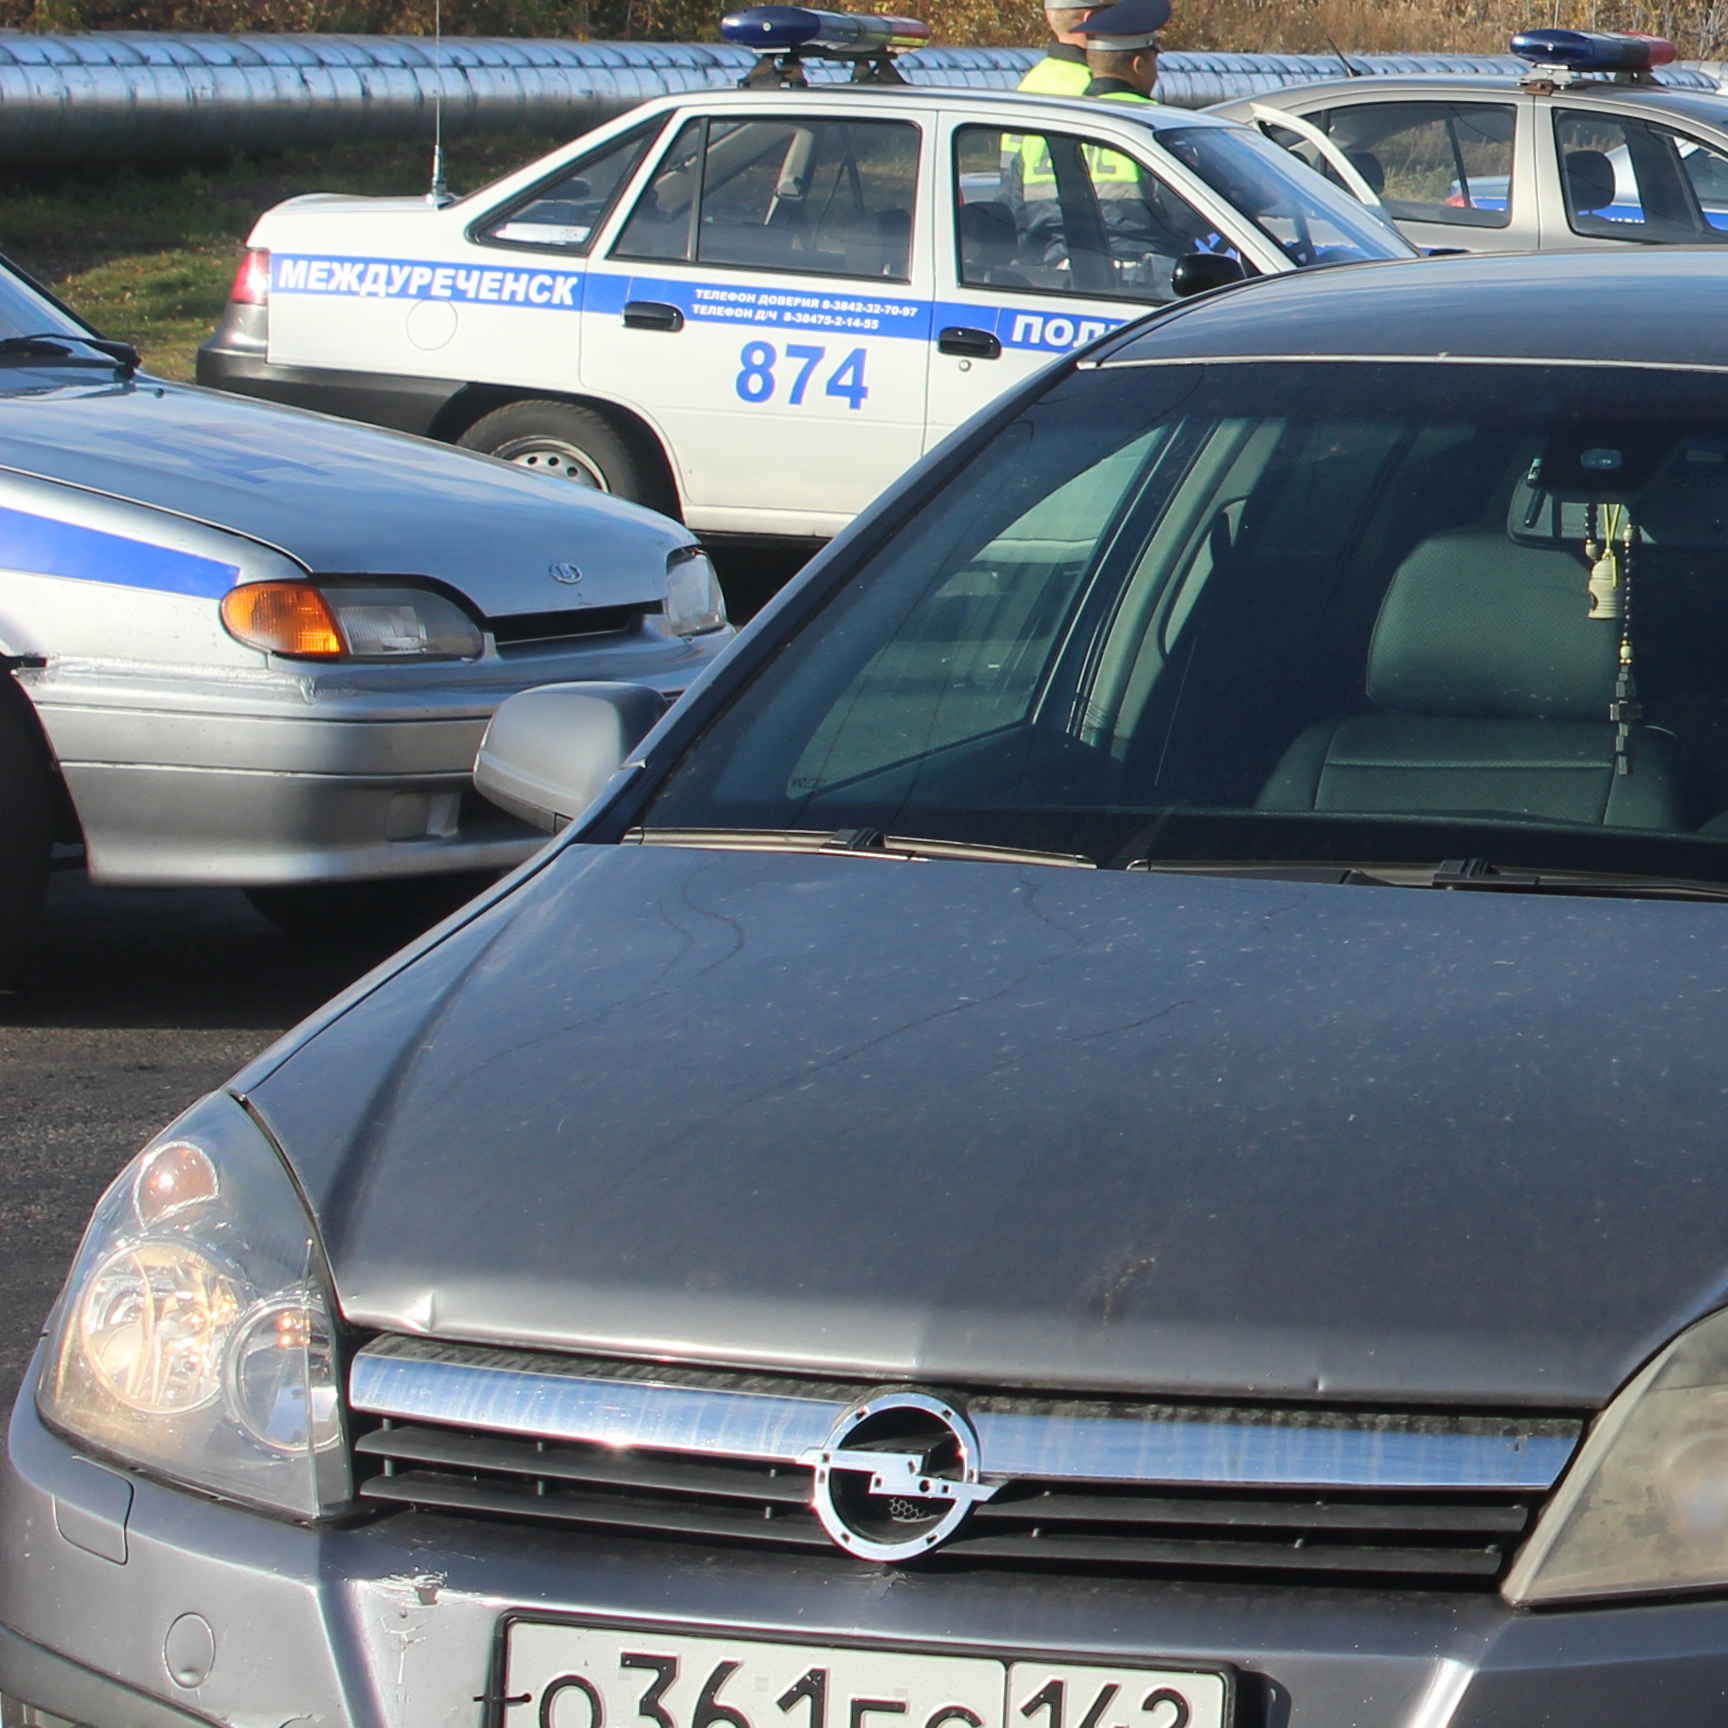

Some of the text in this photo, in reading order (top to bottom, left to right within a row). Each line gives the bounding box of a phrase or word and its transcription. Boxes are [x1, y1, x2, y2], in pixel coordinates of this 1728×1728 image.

[278, 259, 578, 306] МЕЖДУРЕЧЕНСК
[692, 304, 879, 330] ТЕЛЕФОН Д/Ч 8-38475-2-14-55
[695, 288, 918, 317] ТЕЛЕФОН ДОВЕРИЯ 8-3842-32-70-97
[1011, 314, 1118, 348] ПОЛ
[736, 340, 869, 410] 874
